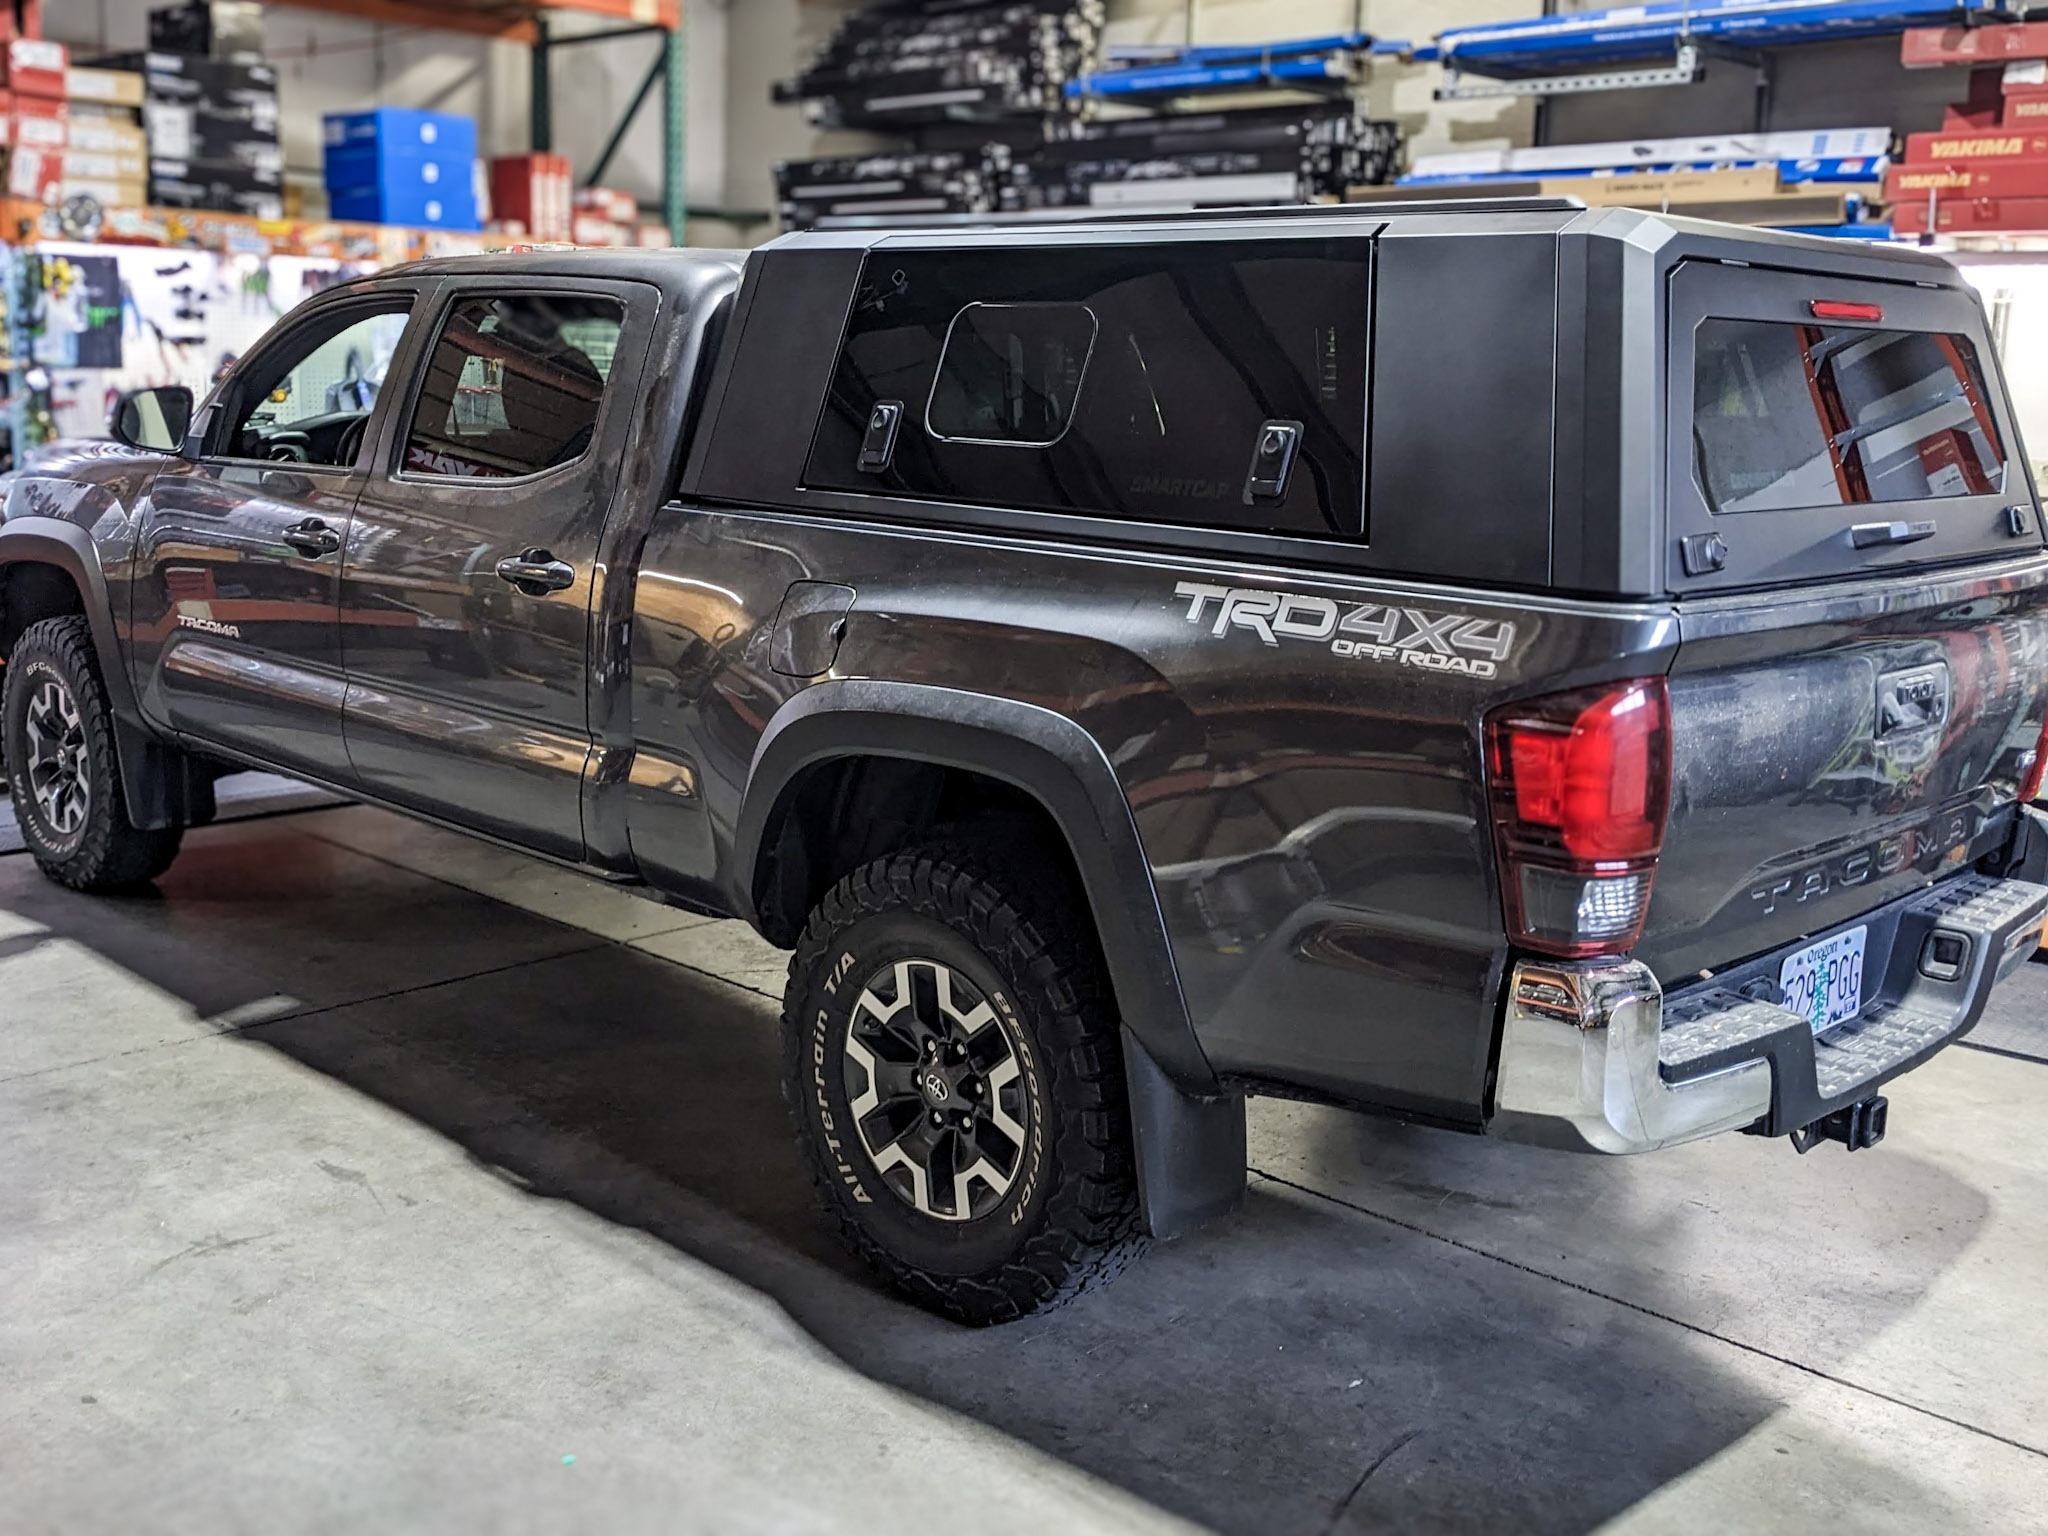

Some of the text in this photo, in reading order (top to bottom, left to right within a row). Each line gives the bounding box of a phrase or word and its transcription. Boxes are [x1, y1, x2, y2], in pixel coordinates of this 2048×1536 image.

[1930, 137, 2025, 159] YAKIMA
[1899, 173, 1972, 190] YAKIMA
[176, 614, 240, 639] TACOMA
[1173, 580, 1341, 648] TRD
[1330, 638, 1498, 681] OFF ROAD
[1751, 817, 1967, 915] TACOMA
[1807, 940, 1839, 964] Oregon
[1826, 949, 1861, 1007] PGG
[811, 951, 873, 1204] All-Terrain T/A
